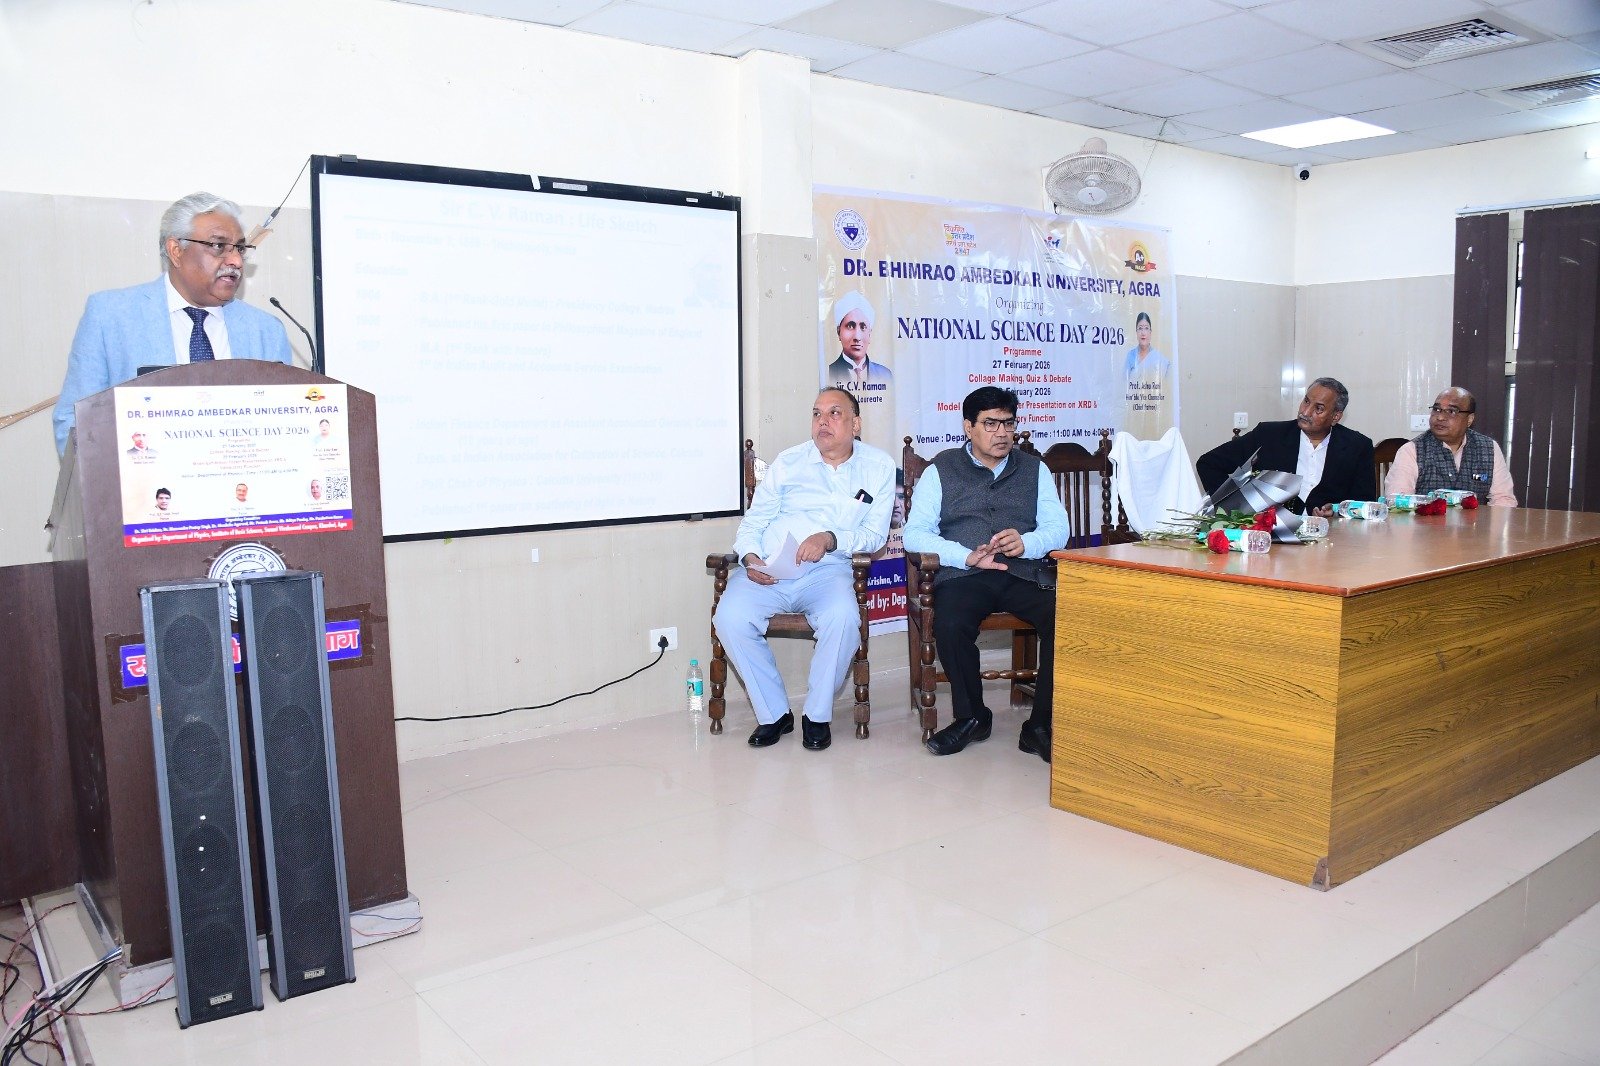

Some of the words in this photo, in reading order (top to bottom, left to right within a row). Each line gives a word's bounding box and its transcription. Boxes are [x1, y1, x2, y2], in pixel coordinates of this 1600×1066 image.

[440, 199, 462, 217] Sir
[508, 205, 563, 226] Raman
[577, 211, 605, 231] Life
[609, 214, 658, 234] Sketch
[843, 258, 873, 277] DR.
[878, 260, 956, 282] BHIMRAO
[960, 267, 1042, 289] AMBEDKAR
[1046, 272, 1125, 297] UNIVERSITY,
[1128, 281, 1160, 297] AGRA
[897, 317, 986, 340] NATIONAL
[990, 320, 1055, 342] SCIENCE
[1060, 324, 1088, 344] DAY
[1092, 326, 1125, 345] 2026
[992, 360, 1002, 369] 27
[1034, 360, 1051, 369] 2026
[968, 374, 996, 384] Collage
[998, 374, 1025, 384] Makng,
[1026, 374, 1041, 383] Quiz
[1043, 374, 1048, 383] &
[1049, 375, 1072, 383] Debate
[862, 381, 886, 391] Raman
[1034, 388, 1051, 396] 2026
[857, 395, 883, 403] Laureate
[127, 410, 144, 419] DR.
[147, 409, 194, 418] BHIMRAO
[197, 407, 251, 417] AMBEDKAR
[254, 406, 312, 416] UNIVERSITY,
[314, 405, 339, 414] AGRA
[937, 402, 960, 412] Model
[1026, 400, 1067, 410] Presentation
[1077, 400, 1092, 409] XRD
[1028, 413, 1056, 423] Function
[164, 429, 216, 440] NATIONAL
[219, 427, 262, 438] SCIENCE
[264, 426, 285, 437] DAY
[285, 426, 310, 435] 2026
[916, 434, 939, 444] Venue
[945, 433, 968, 443] Depar
[1031, 430, 1048, 438] Time
[1053, 429, 1071, 438] 11:00
[1072, 428, 1083, 437] AM
[893, 573, 903, 583] Dr.
[877, 594, 890, 611] by:
[891, 592, 907, 610] Dep
